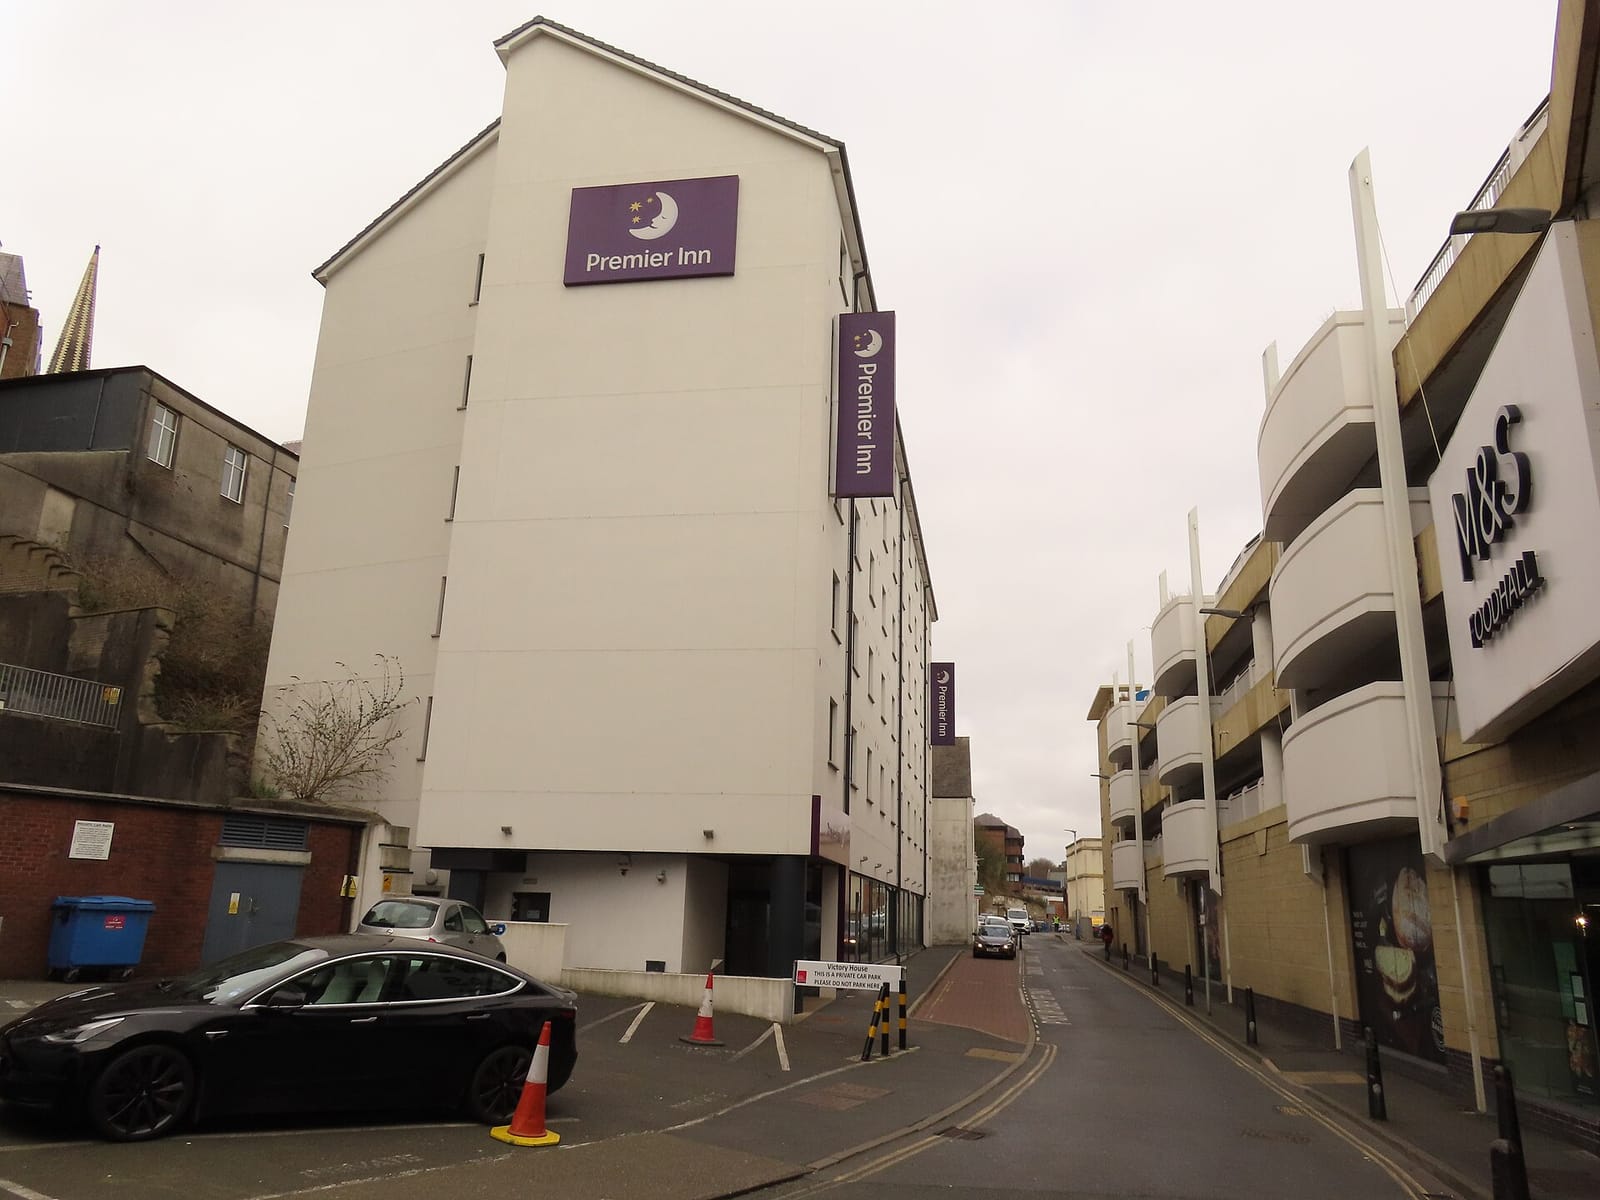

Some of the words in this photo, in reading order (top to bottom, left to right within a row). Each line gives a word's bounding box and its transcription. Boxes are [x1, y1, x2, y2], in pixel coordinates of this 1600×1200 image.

[586, 249, 673, 272] Premier
[678, 247, 711, 265] Inn
[857, 363, 877, 440] Premier
[856, 444, 876, 474] Inn
[1452, 404, 1531, 582] M&S
[938, 686, 948, 723] Premier
[938, 723, 948, 737] Inn
[827, 964, 848, 972] Victory
